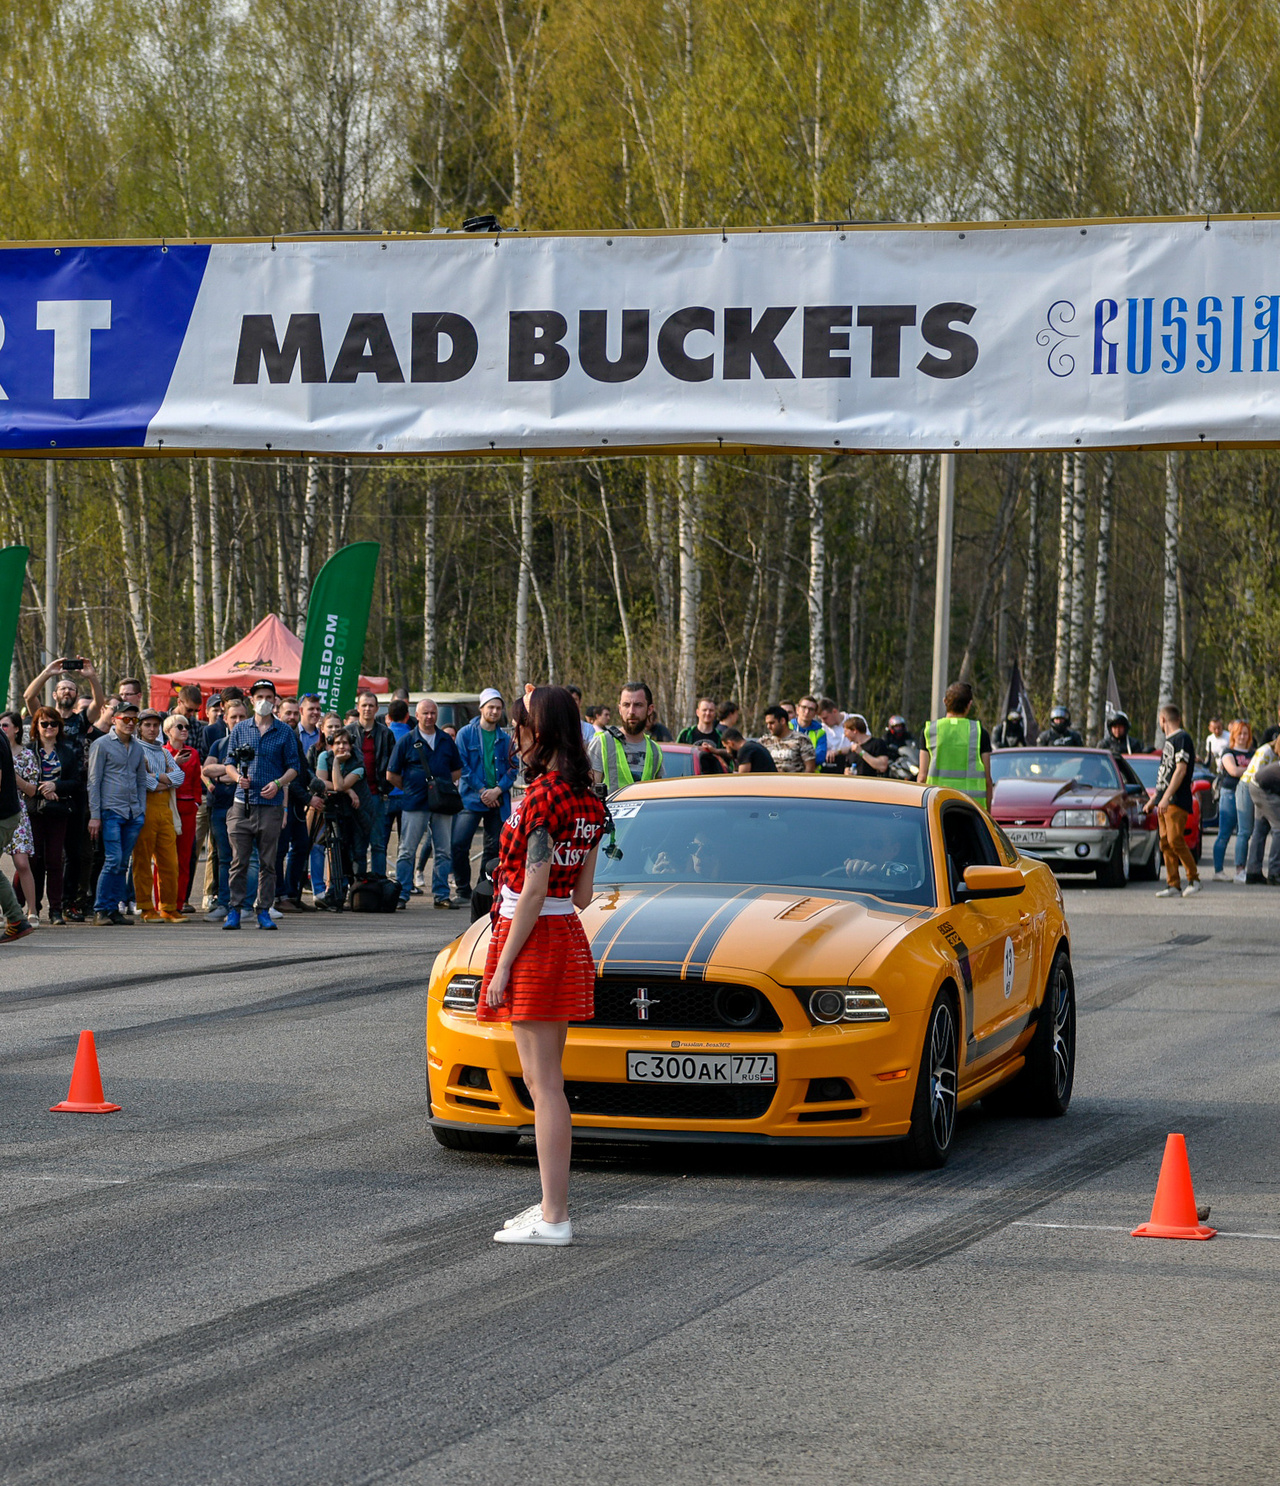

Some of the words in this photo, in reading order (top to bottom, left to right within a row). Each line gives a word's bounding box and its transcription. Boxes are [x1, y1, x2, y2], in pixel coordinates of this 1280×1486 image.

[233, 313, 479, 385] MAD
[507, 302, 979, 383] BUCKETS
[317, 614, 339, 716] REEDOM
[327, 656, 345, 712] inance
[573, 818, 600, 843] Hey
[1005, 948, 1013, 977] 13
[732, 1056, 769, 1074] 777
[741, 1073, 760, 1081] RUS
